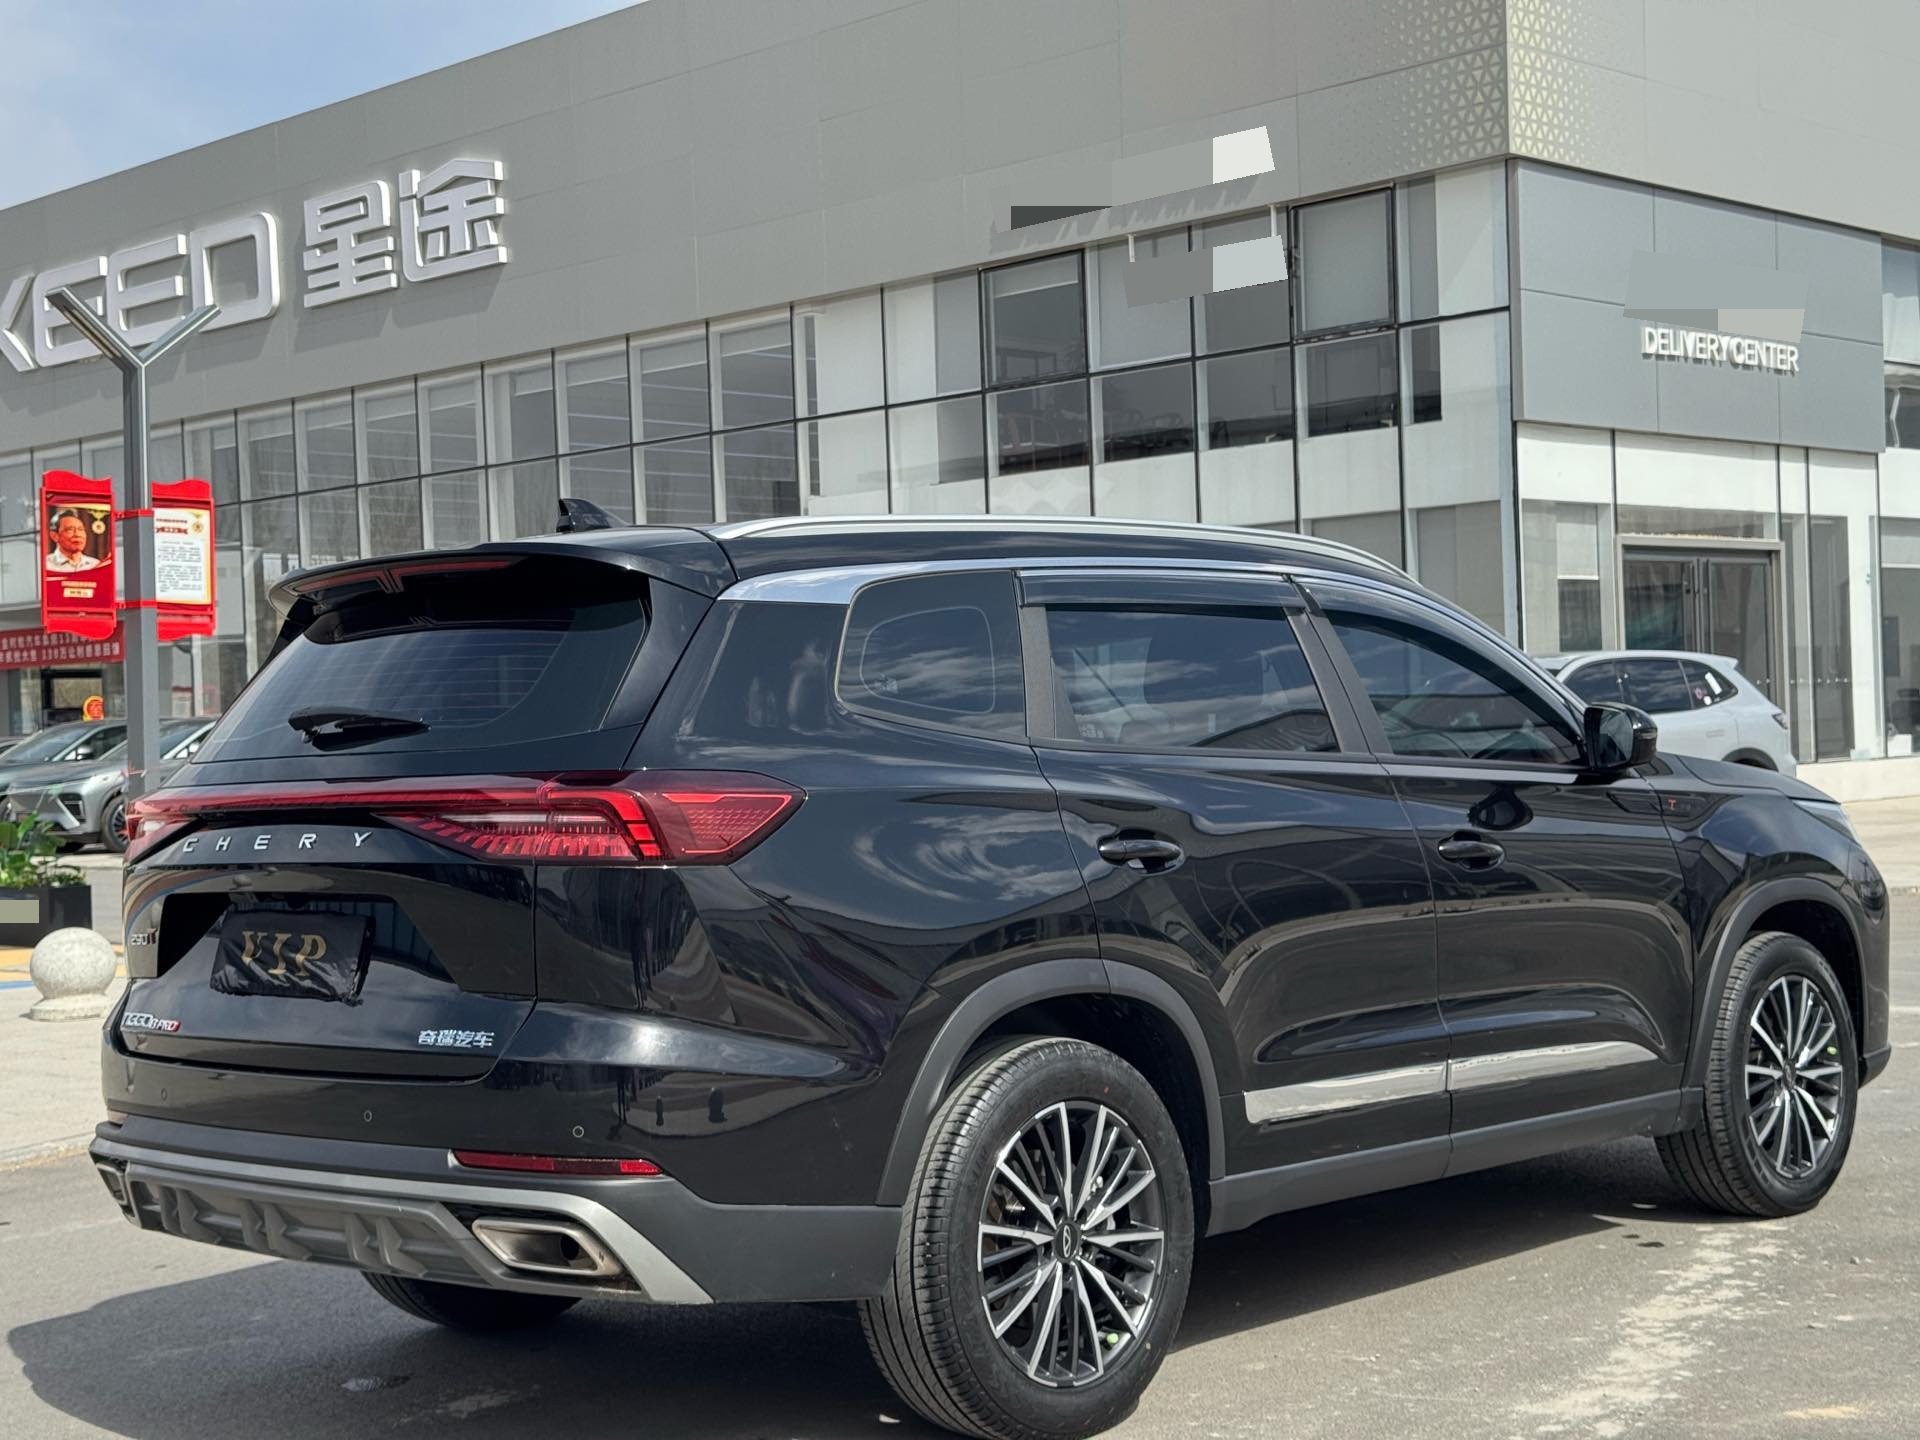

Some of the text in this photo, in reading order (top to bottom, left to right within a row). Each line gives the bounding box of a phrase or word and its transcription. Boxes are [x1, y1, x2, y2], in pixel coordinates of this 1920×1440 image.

[304, 158, 510, 308] 星途
[1643, 327, 1800, 371] DELIVERY CENTER
[182, 831, 373, 853] CHERY
[241, 931, 327, 977] VIP
[418, 1029, 495, 1049] 奇瑞汽车
